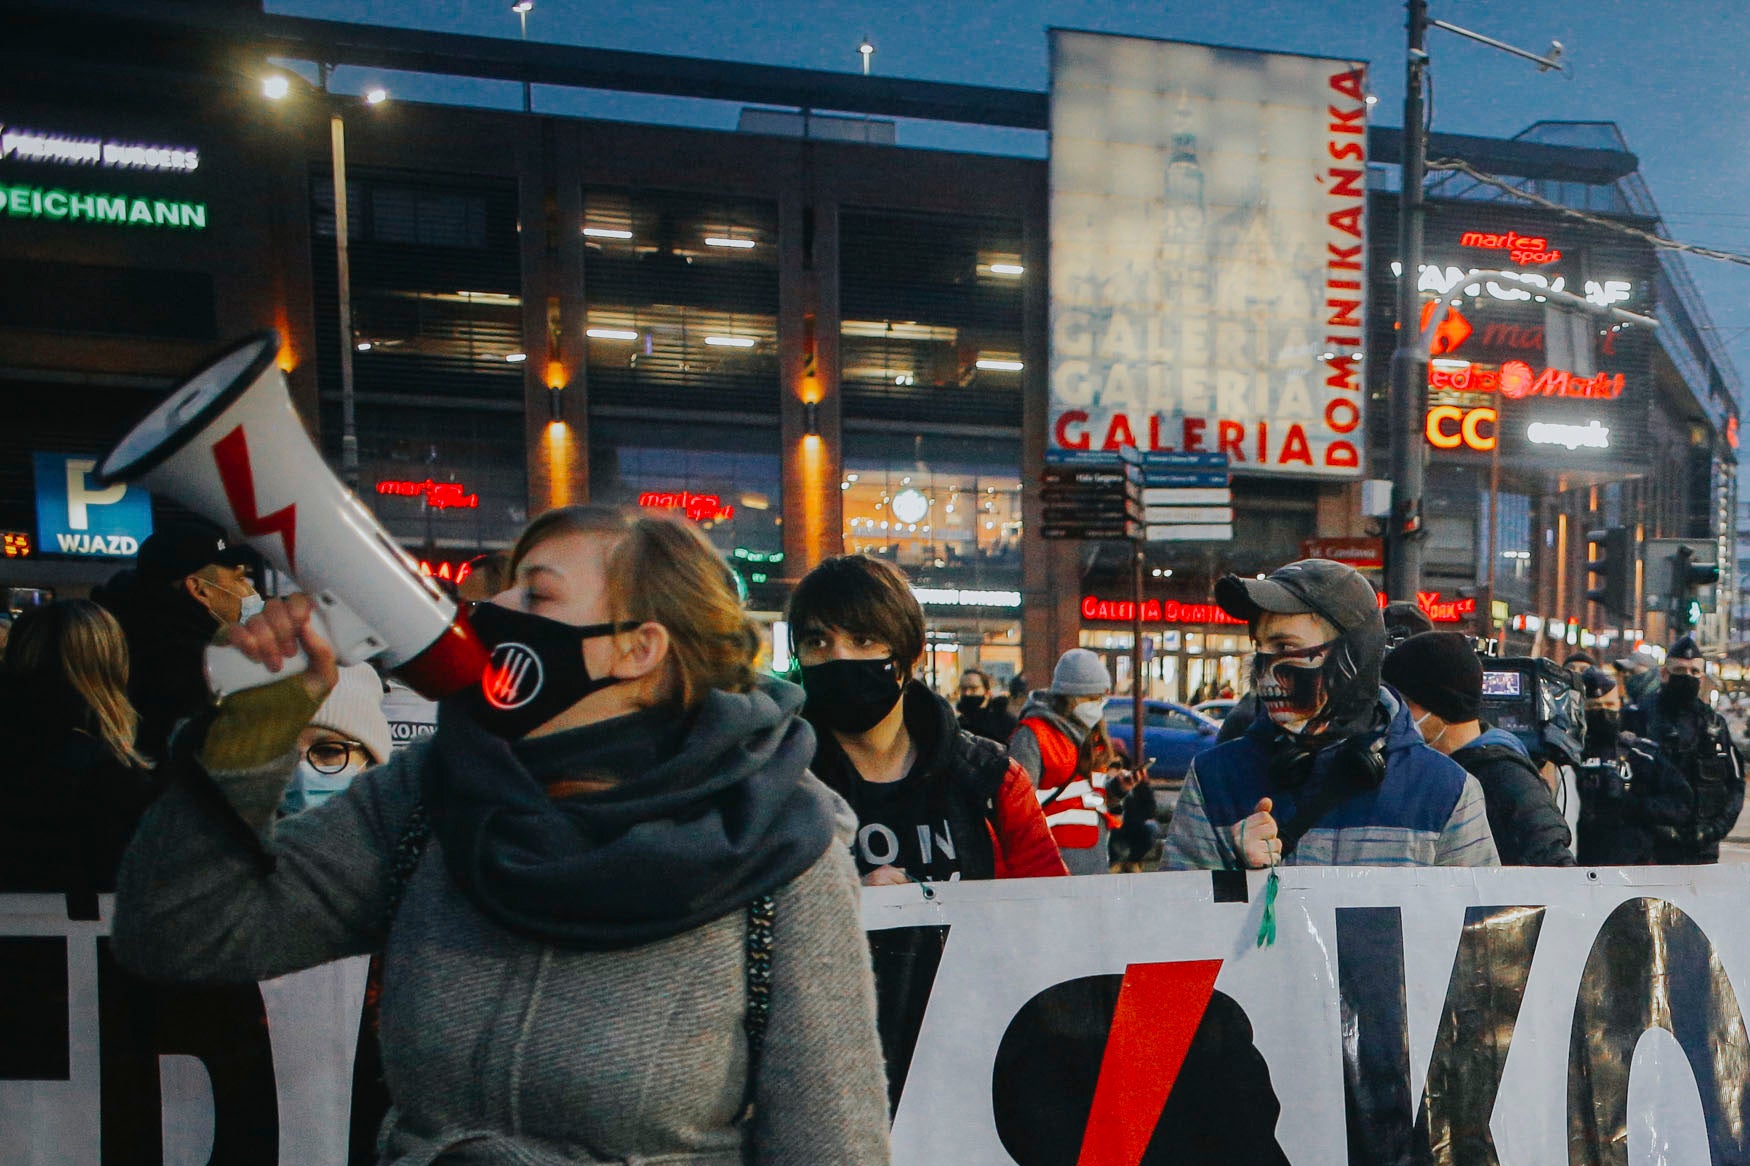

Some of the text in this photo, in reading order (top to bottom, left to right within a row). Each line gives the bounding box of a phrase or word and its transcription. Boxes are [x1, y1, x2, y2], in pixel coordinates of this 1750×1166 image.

[1460, 231, 1548, 252] martes
[1509, 249, 1562, 265] sport
[1316, 67, 1366, 469] DOMINIKAŃSKA
[1428, 362, 1625, 399] edia Markt
[1055, 409, 1314, 467] GALERIA
[66, 459, 127, 530] P
[56, 533, 138, 555] WJAZD
